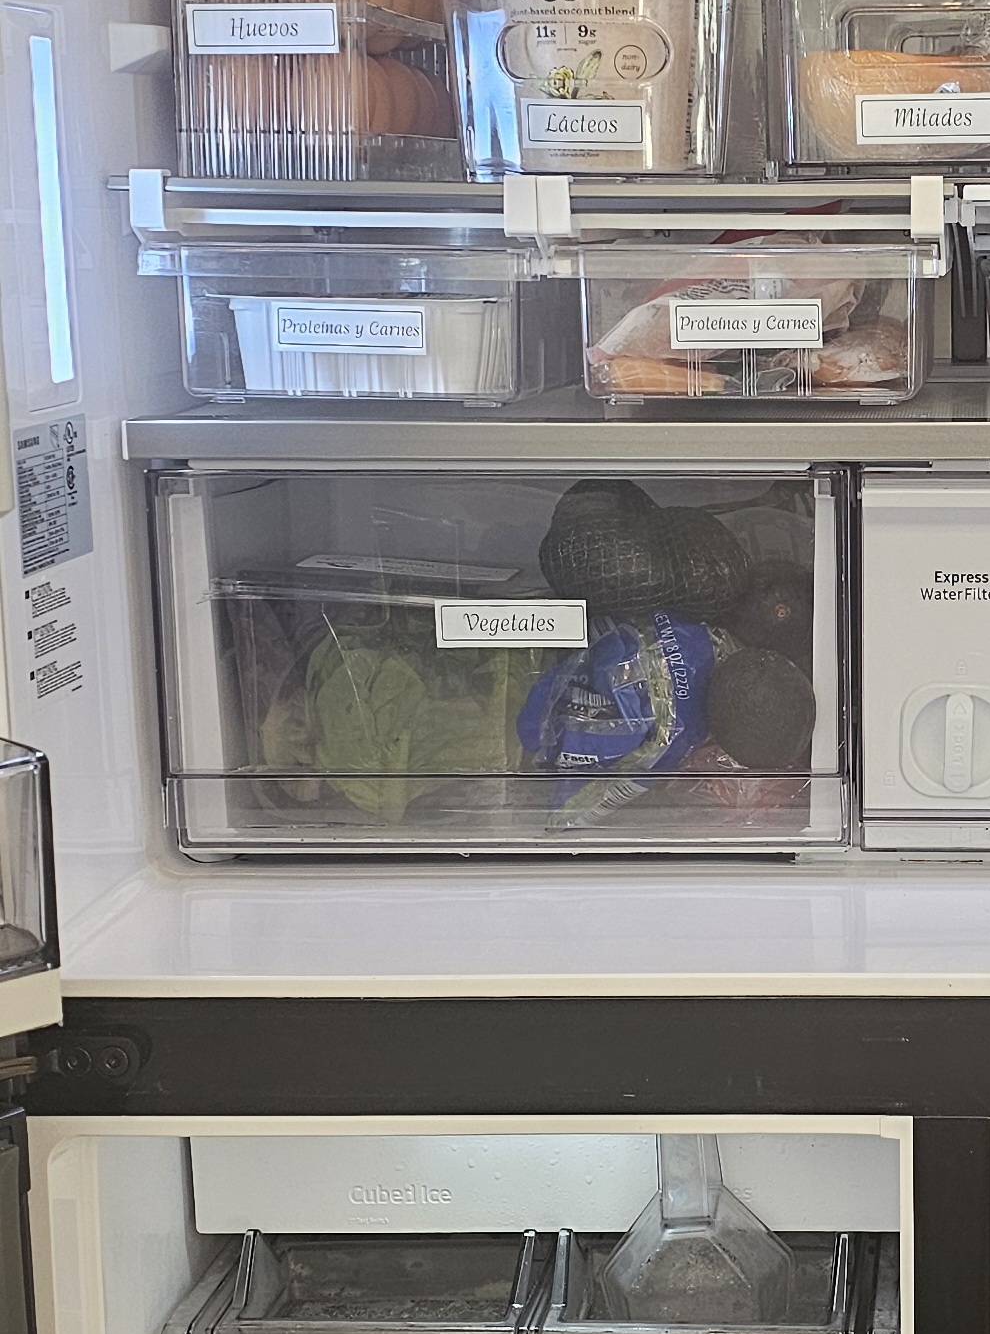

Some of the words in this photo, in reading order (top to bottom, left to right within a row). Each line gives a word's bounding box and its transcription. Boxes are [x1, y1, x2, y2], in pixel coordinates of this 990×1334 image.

[604, 6, 636, 16] blend
[230, 17, 299, 40] Huevos
[536, 25, 557, 39] 11g
[577, 24, 598, 39] 9g
[544, 113, 618, 134] Lácteos
[894, 107, 973, 128] Mitades
[355, 323, 364, 339] y
[369, 320, 421, 338] Carnes
[752, 319, 761, 334] y
[766, 315, 817, 331] Carnes
[934, 570, 990, 587] Express
[463, 612, 555, 637] Vegetales
[666, 645, 679, 653] 8
[563, 753, 597, 764] Facts
[348, 1183, 416, 1205] Cubed
[420, 1184, 452, 1205] Ice
